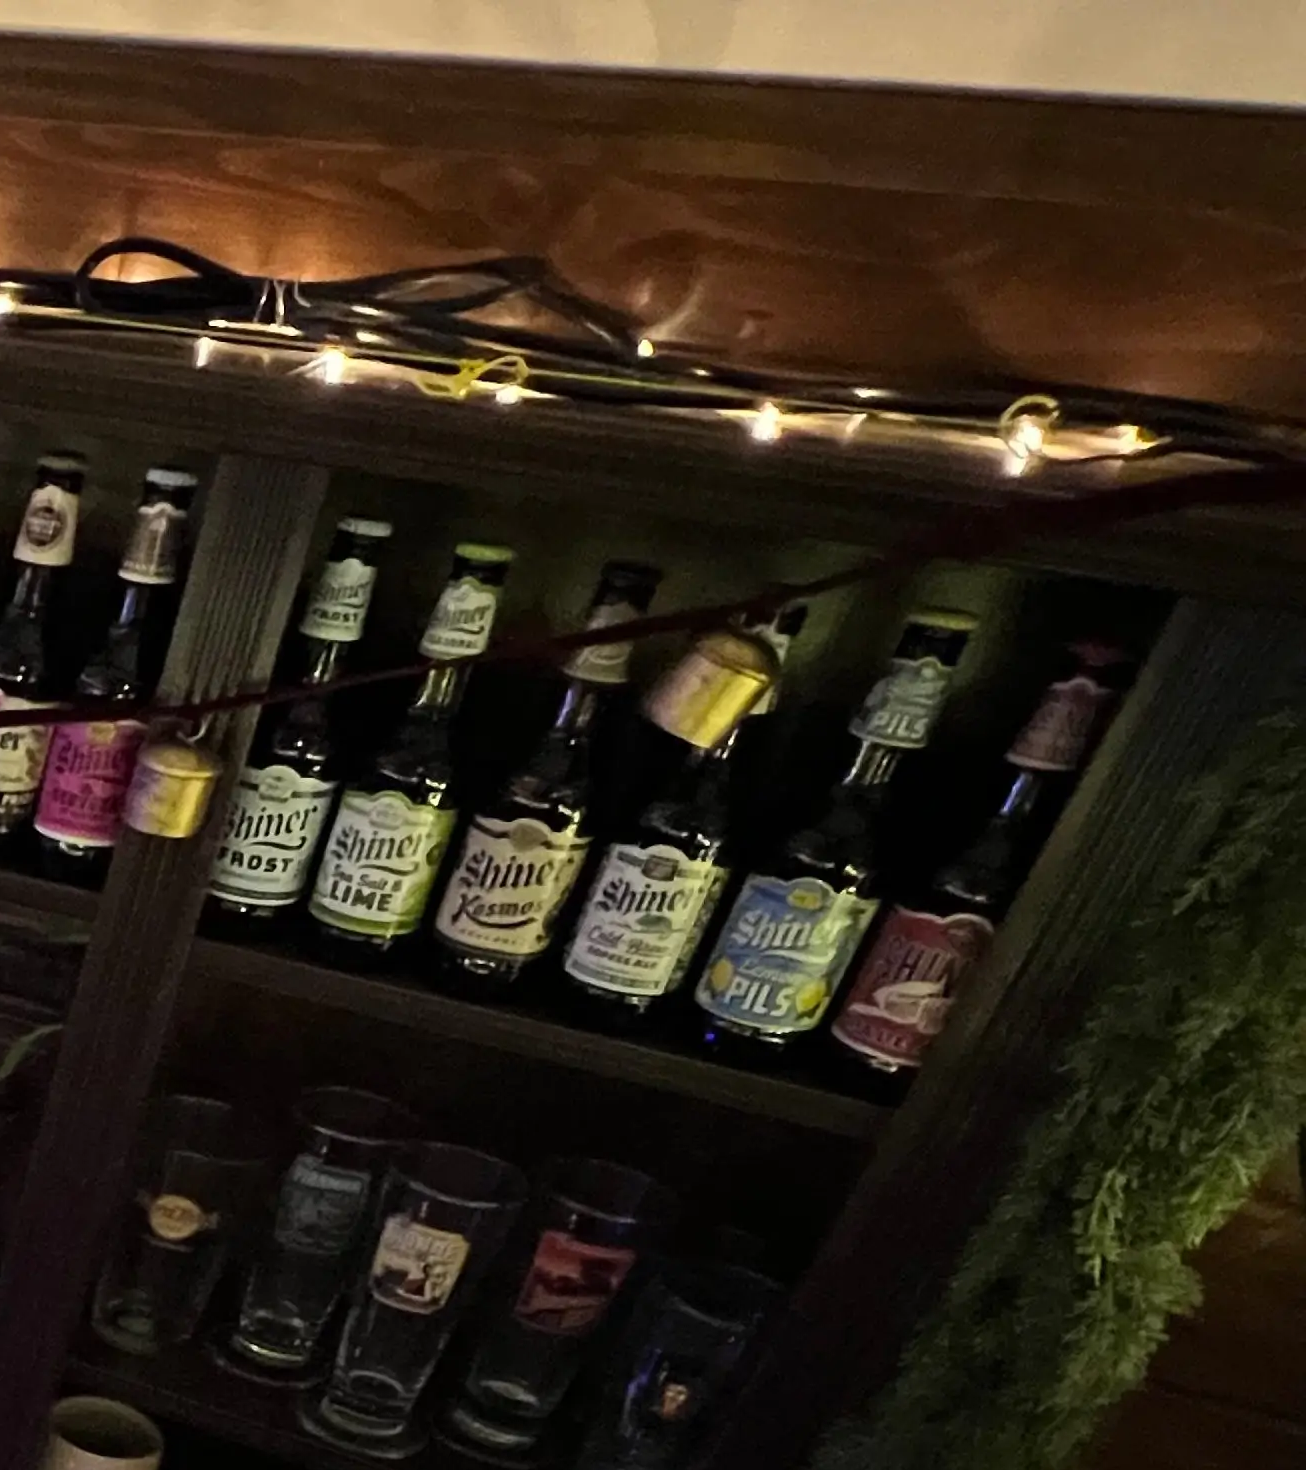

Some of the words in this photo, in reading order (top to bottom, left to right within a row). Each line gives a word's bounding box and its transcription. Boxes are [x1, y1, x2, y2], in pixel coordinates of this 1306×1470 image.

[871, 710, 930, 739] PILS
[216, 845, 295, 874] FROST
[330, 825, 433, 864] Shiner
[328, 880, 394, 914] LIME
[722, 975, 796, 1018] PILS
